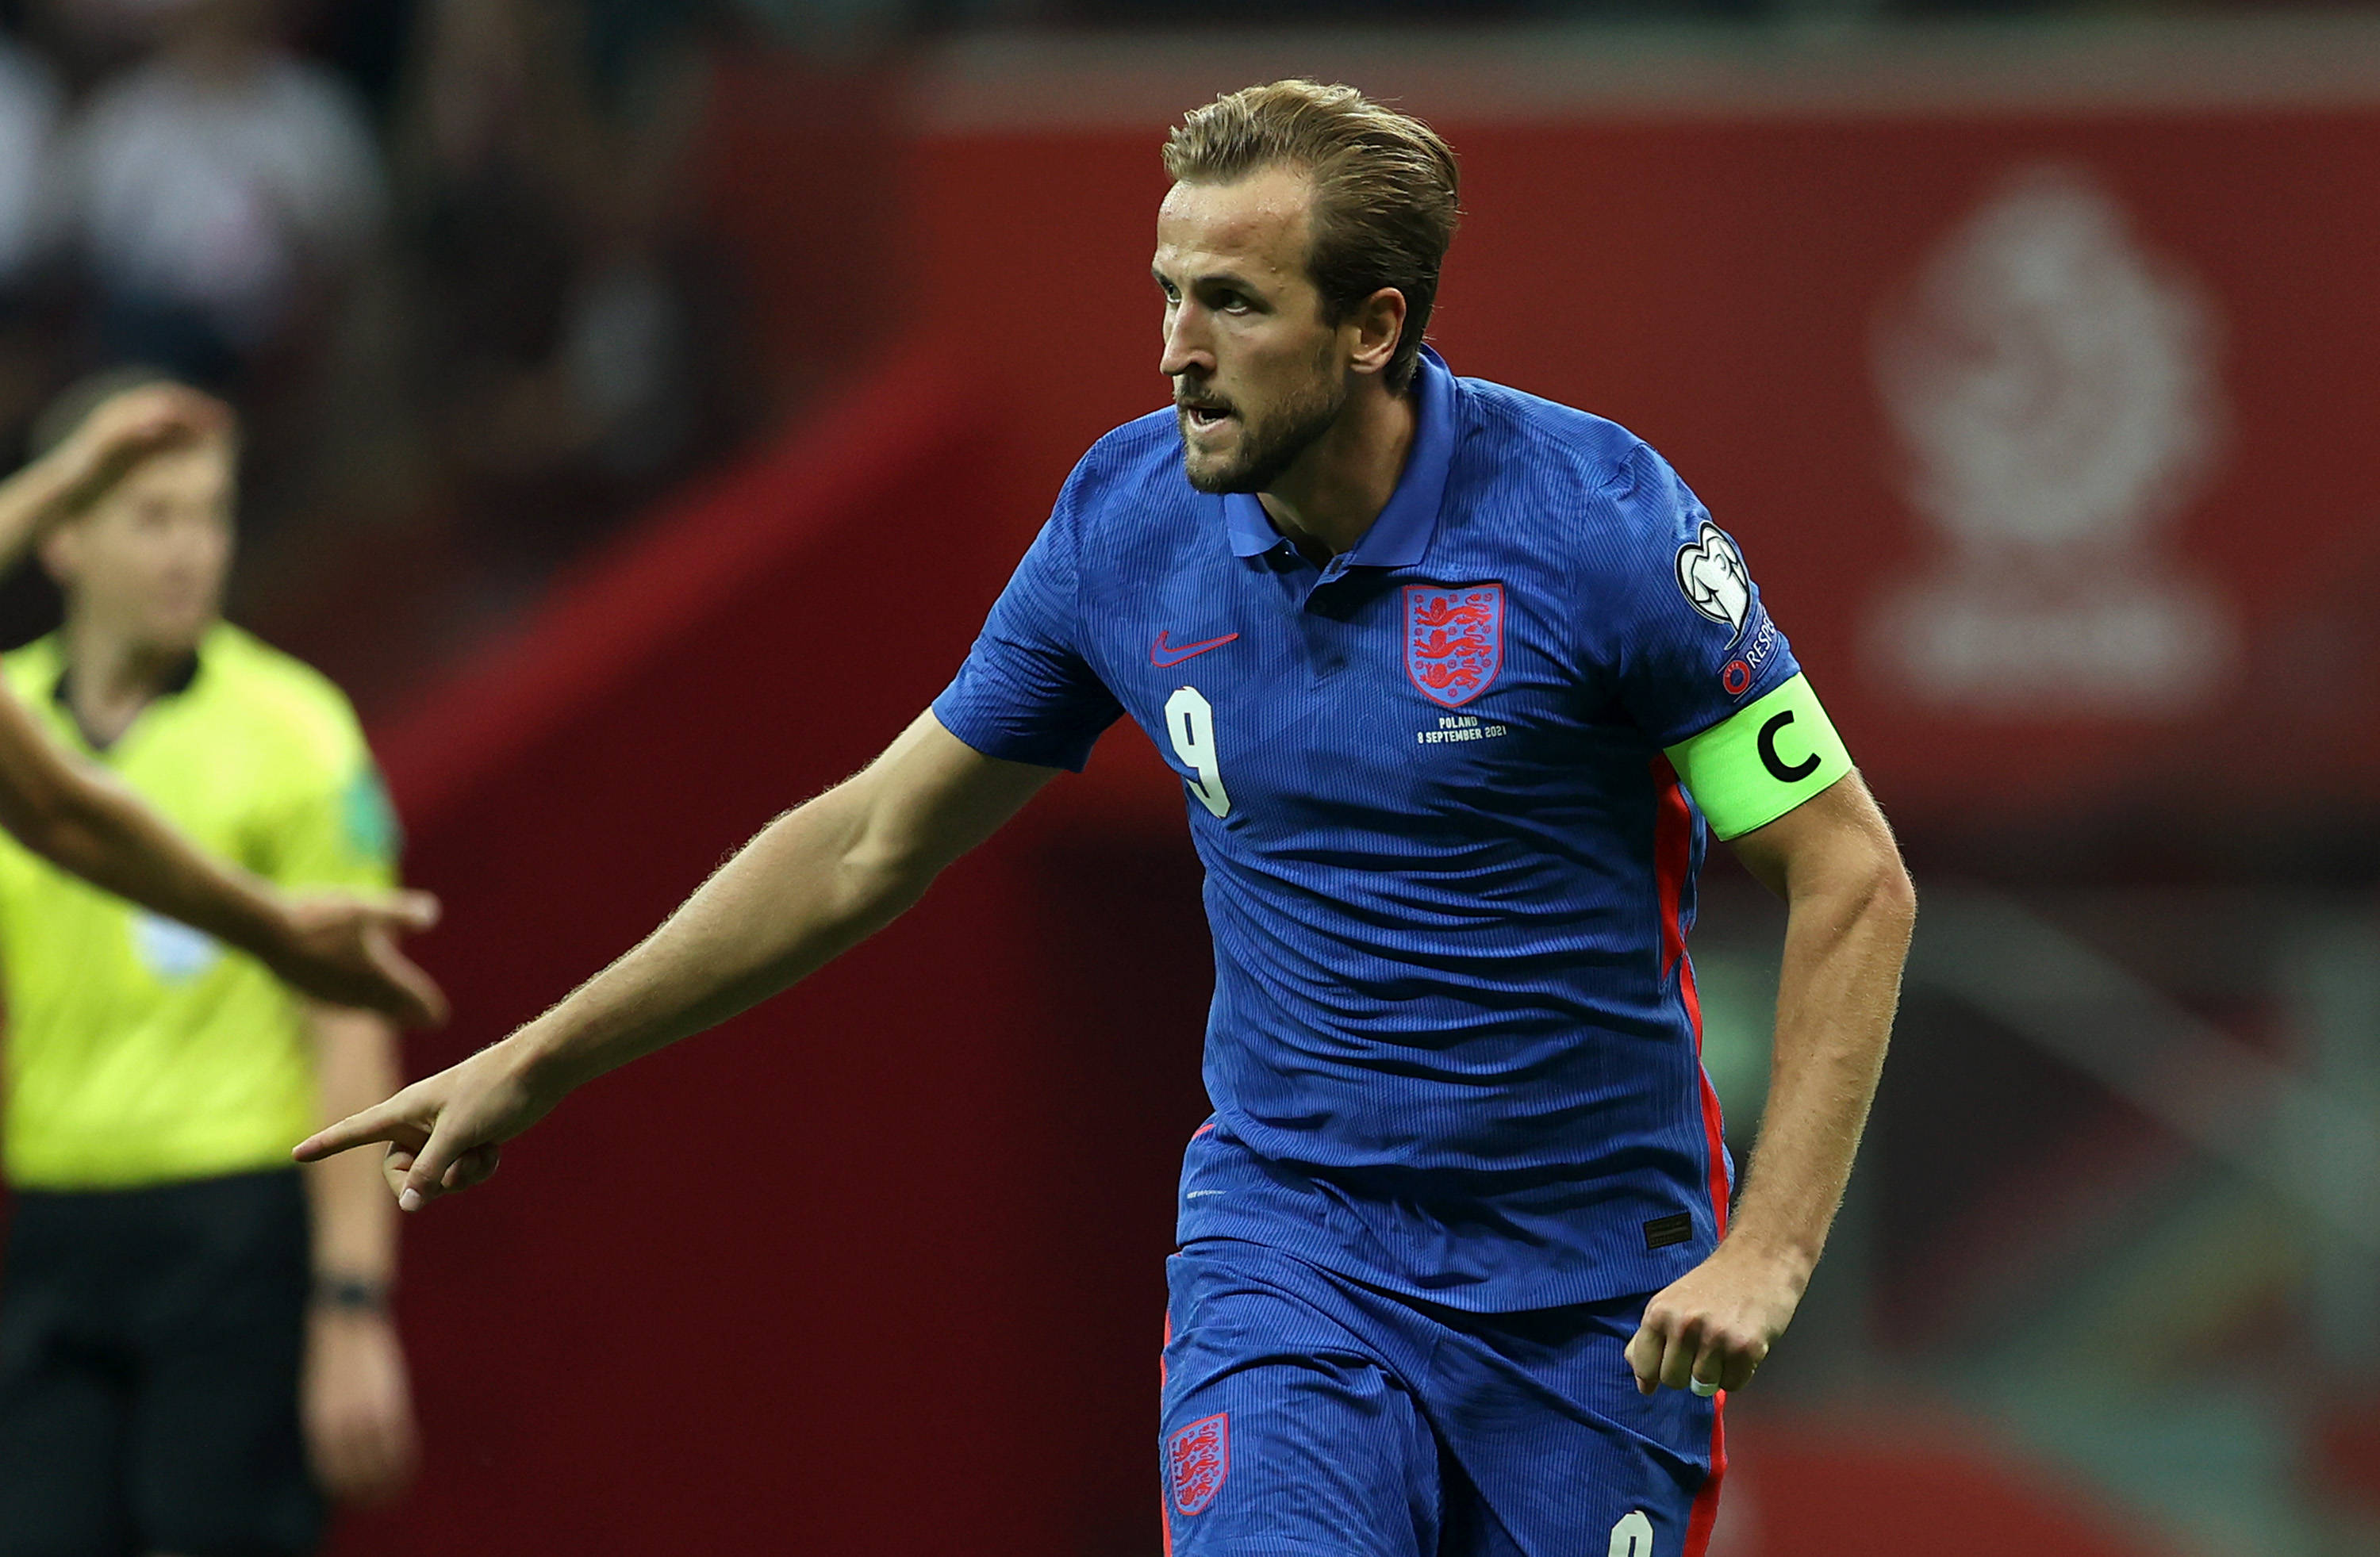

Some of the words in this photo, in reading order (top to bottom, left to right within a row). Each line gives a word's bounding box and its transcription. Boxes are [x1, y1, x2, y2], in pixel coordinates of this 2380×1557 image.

[1417, 731, 1424, 744] 8
[1426, 728, 1483, 743] SEPTEMBER
[1484, 725, 1507, 738] 2021
[1438, 716, 1478, 729] POLAND
[1165, 685, 1230, 819] 9
[1757, 710, 1821, 783] C
